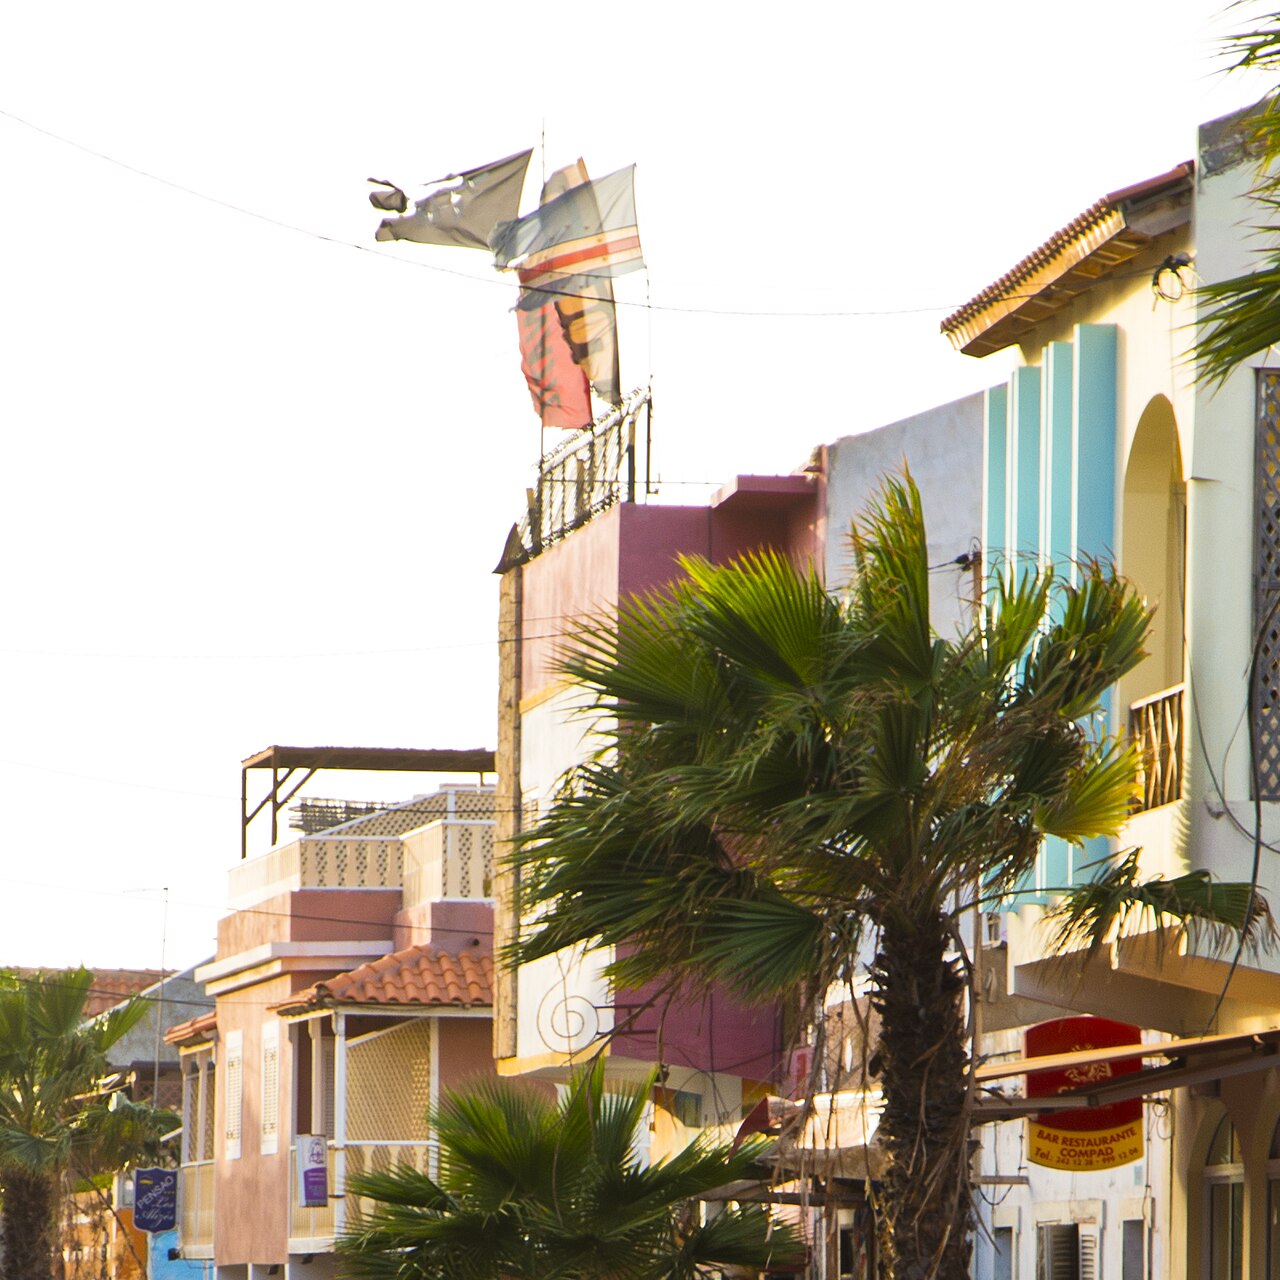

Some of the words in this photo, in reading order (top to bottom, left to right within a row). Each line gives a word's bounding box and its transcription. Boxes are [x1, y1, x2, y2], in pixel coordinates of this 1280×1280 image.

[1037, 1129, 1060, 1145] BAR
[1060, 1127, 1137, 1148] RESTAURANTE
[1060, 1146, 1114, 1158] COMPAD
